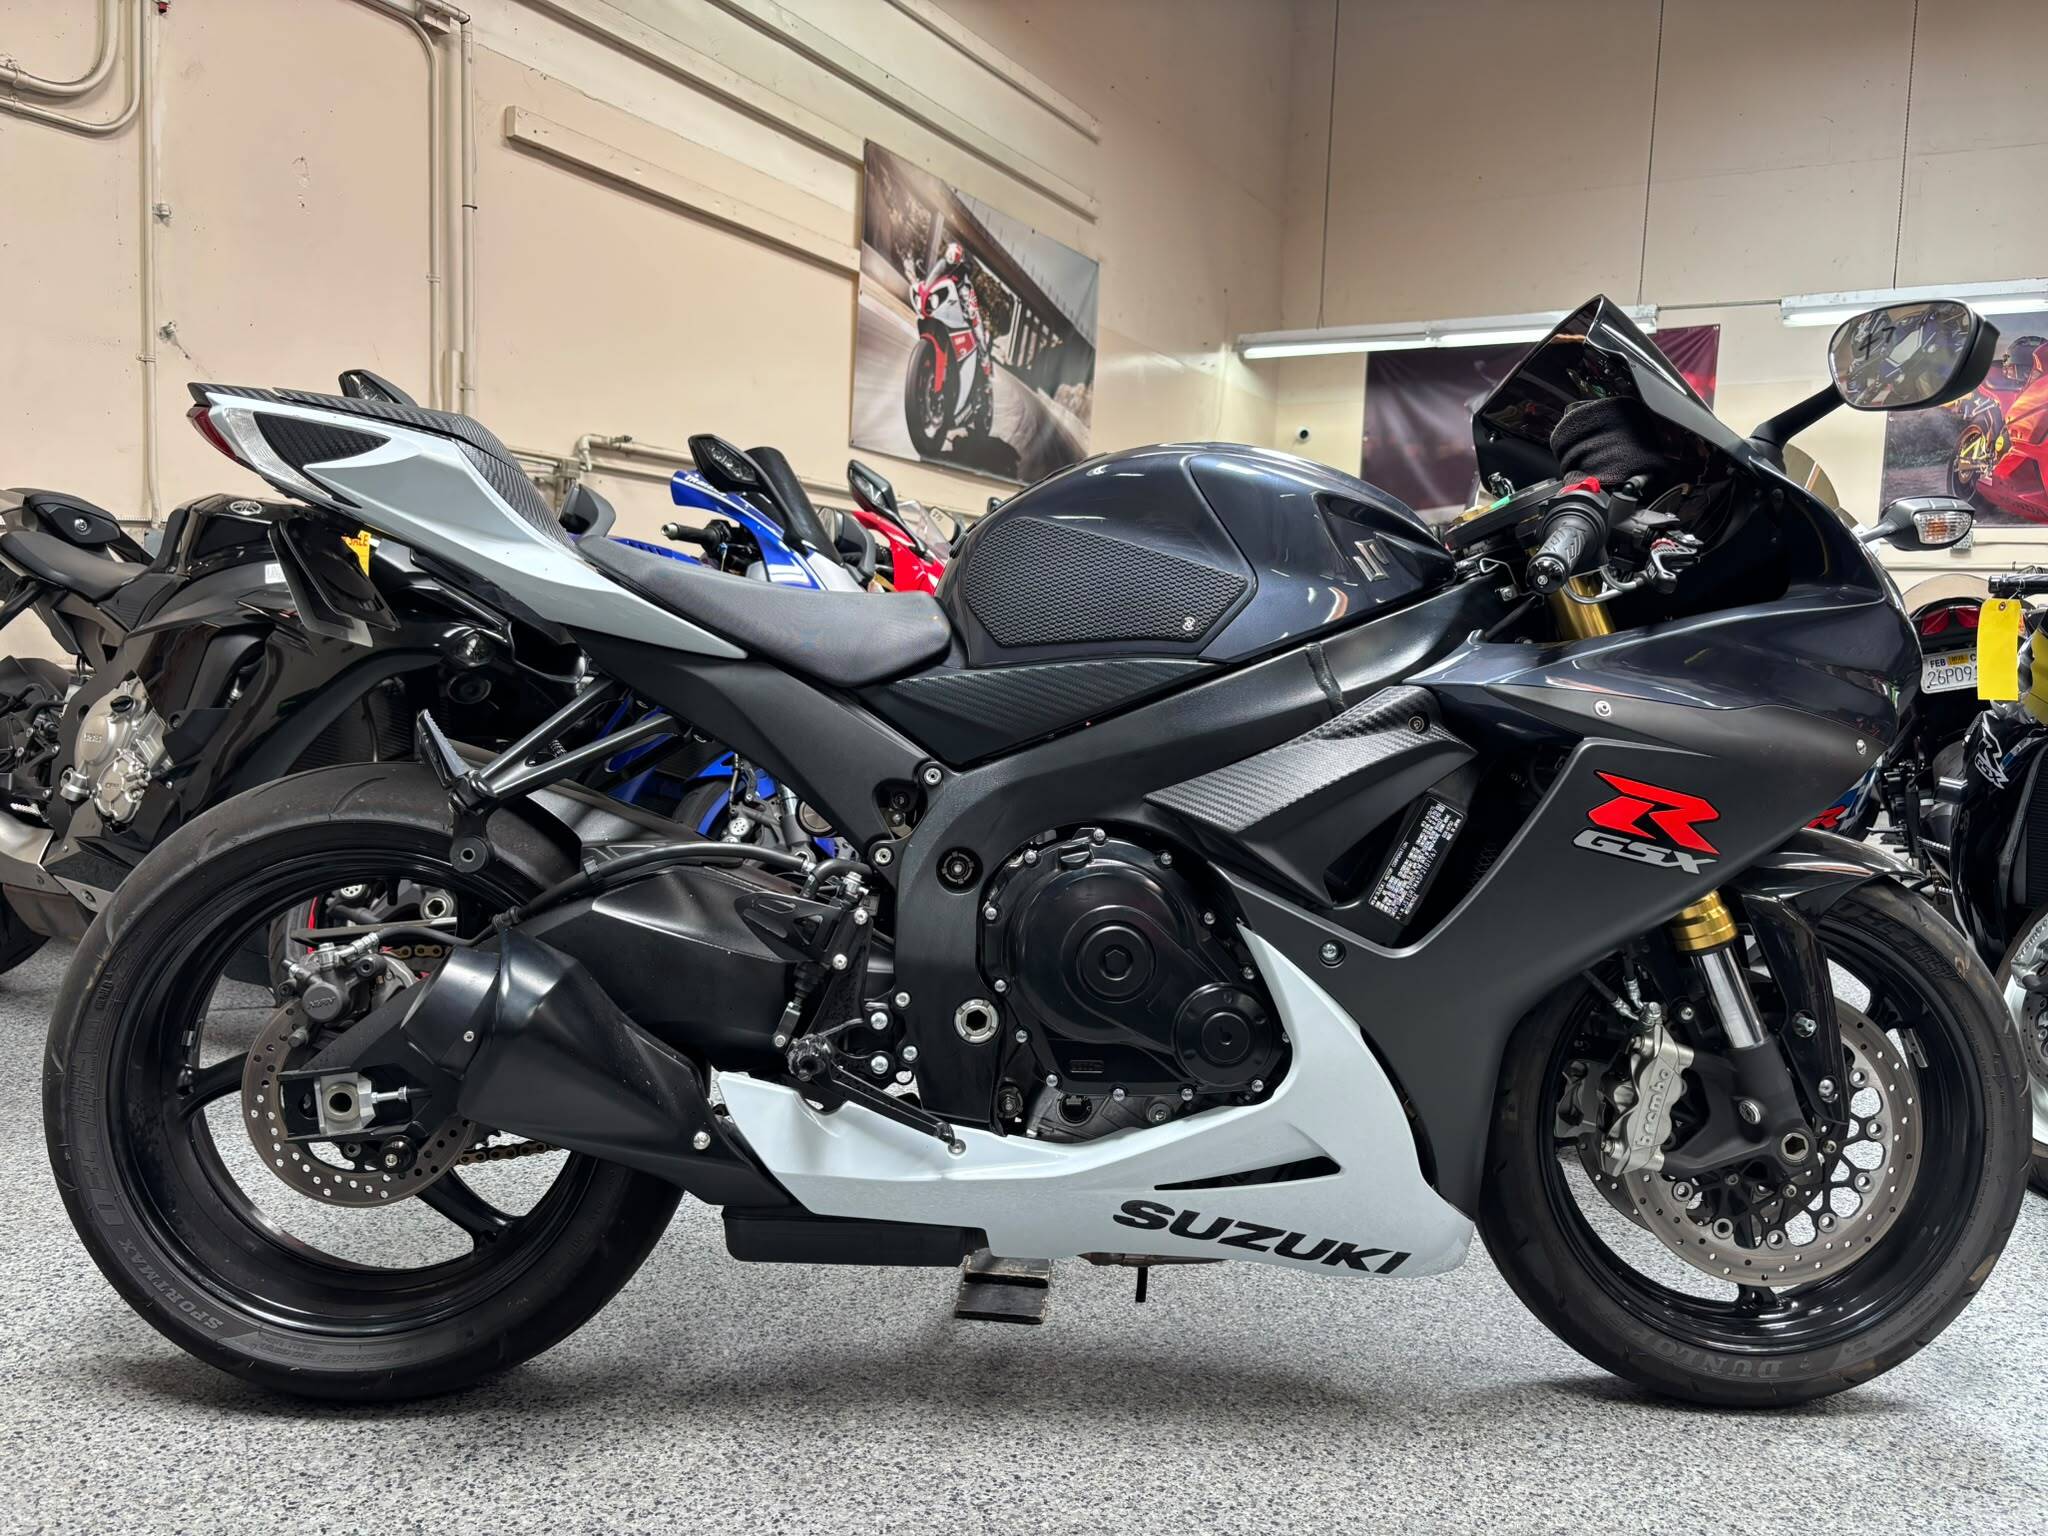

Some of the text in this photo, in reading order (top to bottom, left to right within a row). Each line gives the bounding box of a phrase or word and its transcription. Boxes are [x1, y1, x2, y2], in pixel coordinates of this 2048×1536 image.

[1927, 666, 1977, 687] 26P09
[1930, 658, 1946, 668] FEB
[1587, 771, 1721, 855] R
[1573, 829, 1718, 874] GSX
[1634, 1069, 1669, 1147] brembo
[1113, 1200, 1412, 1275] SUZUKI
[117, 1238, 224, 1330] SPORTMAX
